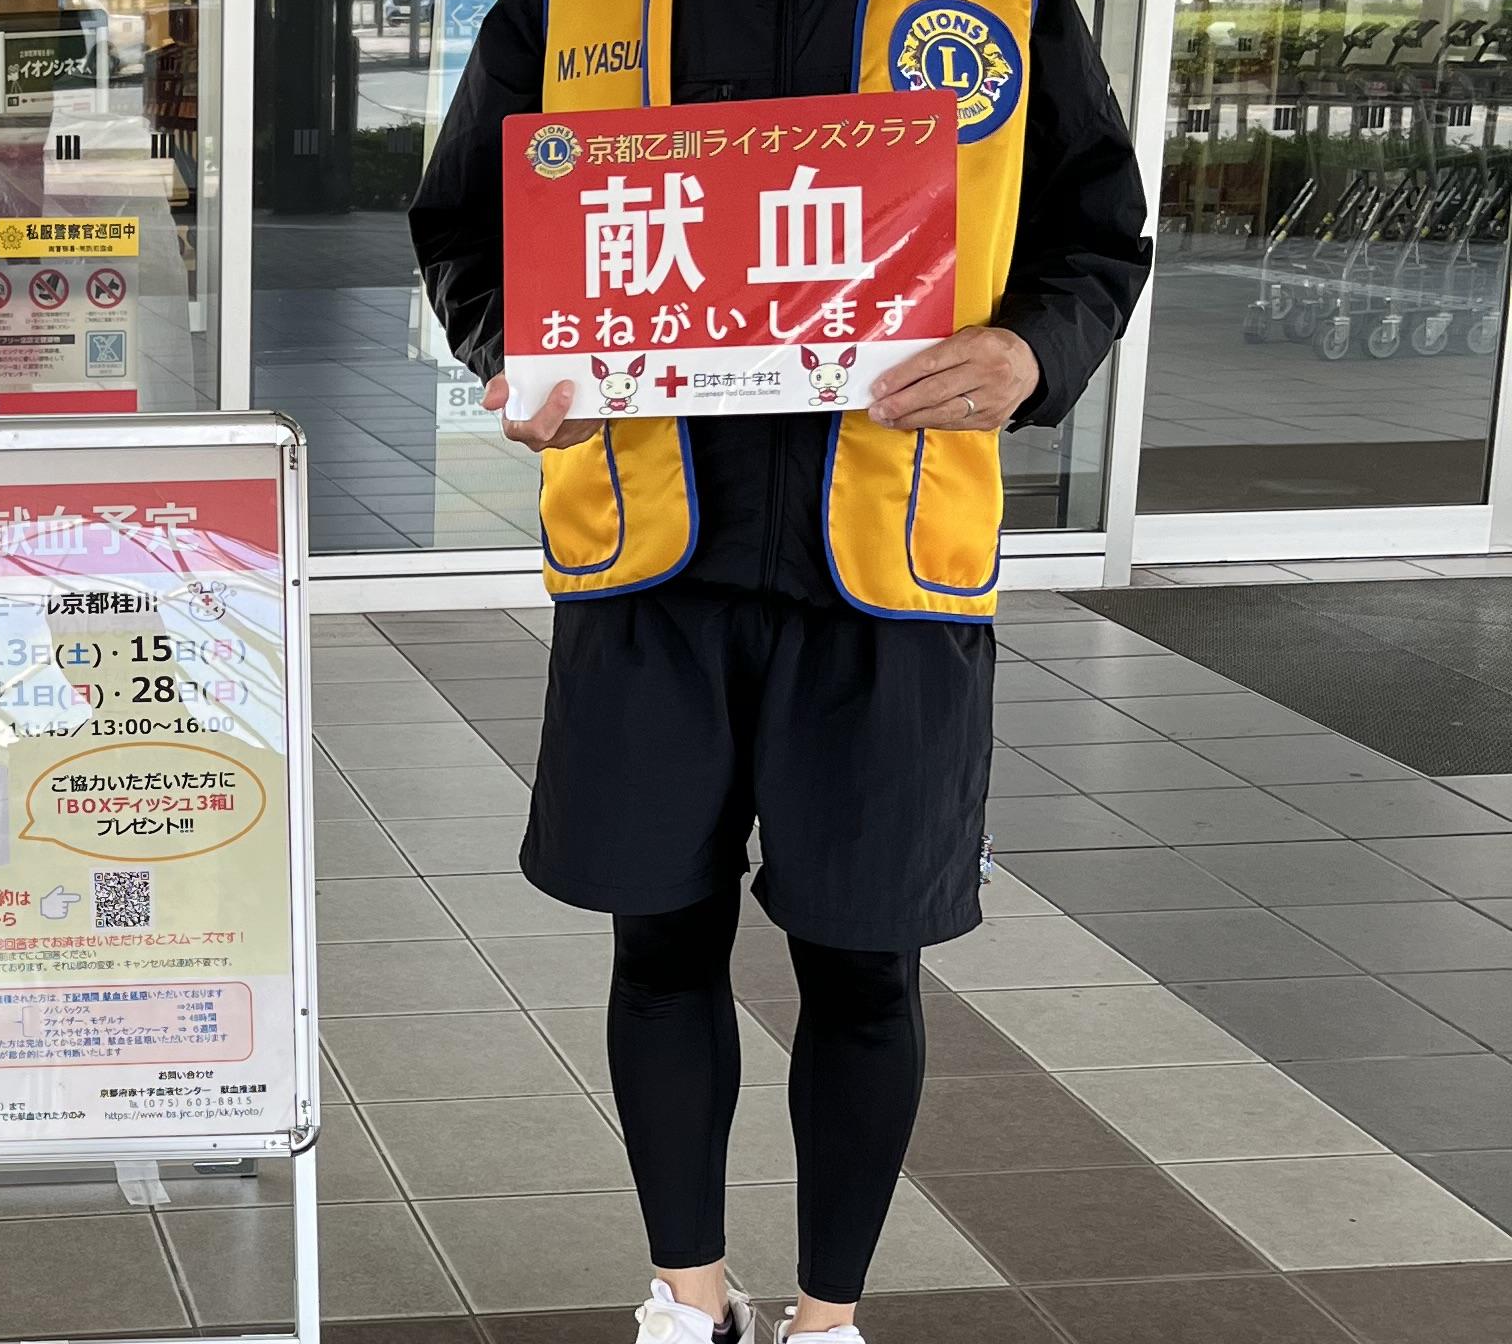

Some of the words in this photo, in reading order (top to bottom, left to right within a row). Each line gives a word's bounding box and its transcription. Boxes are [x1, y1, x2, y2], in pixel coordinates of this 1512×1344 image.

[916, 14, 983, 39] LIONS
[557, 39, 643, 83] M.YASU
[938, 46, 969, 88] L
[547, 141, 564, 160] L
[585, 113, 940, 166] 京都乙訓ライオンズクラブ
[26, 224, 135, 240] 私服警察官巡回中
[580, 164, 875, 299] 献血
[541, 294, 917, 351] おねがいします
[693, 370, 781, 389] 日本赤十字社
[51, 771, 236, 792] ご協力いただいた方に
[158, 1070, 214, 1081] お問い合わせ
